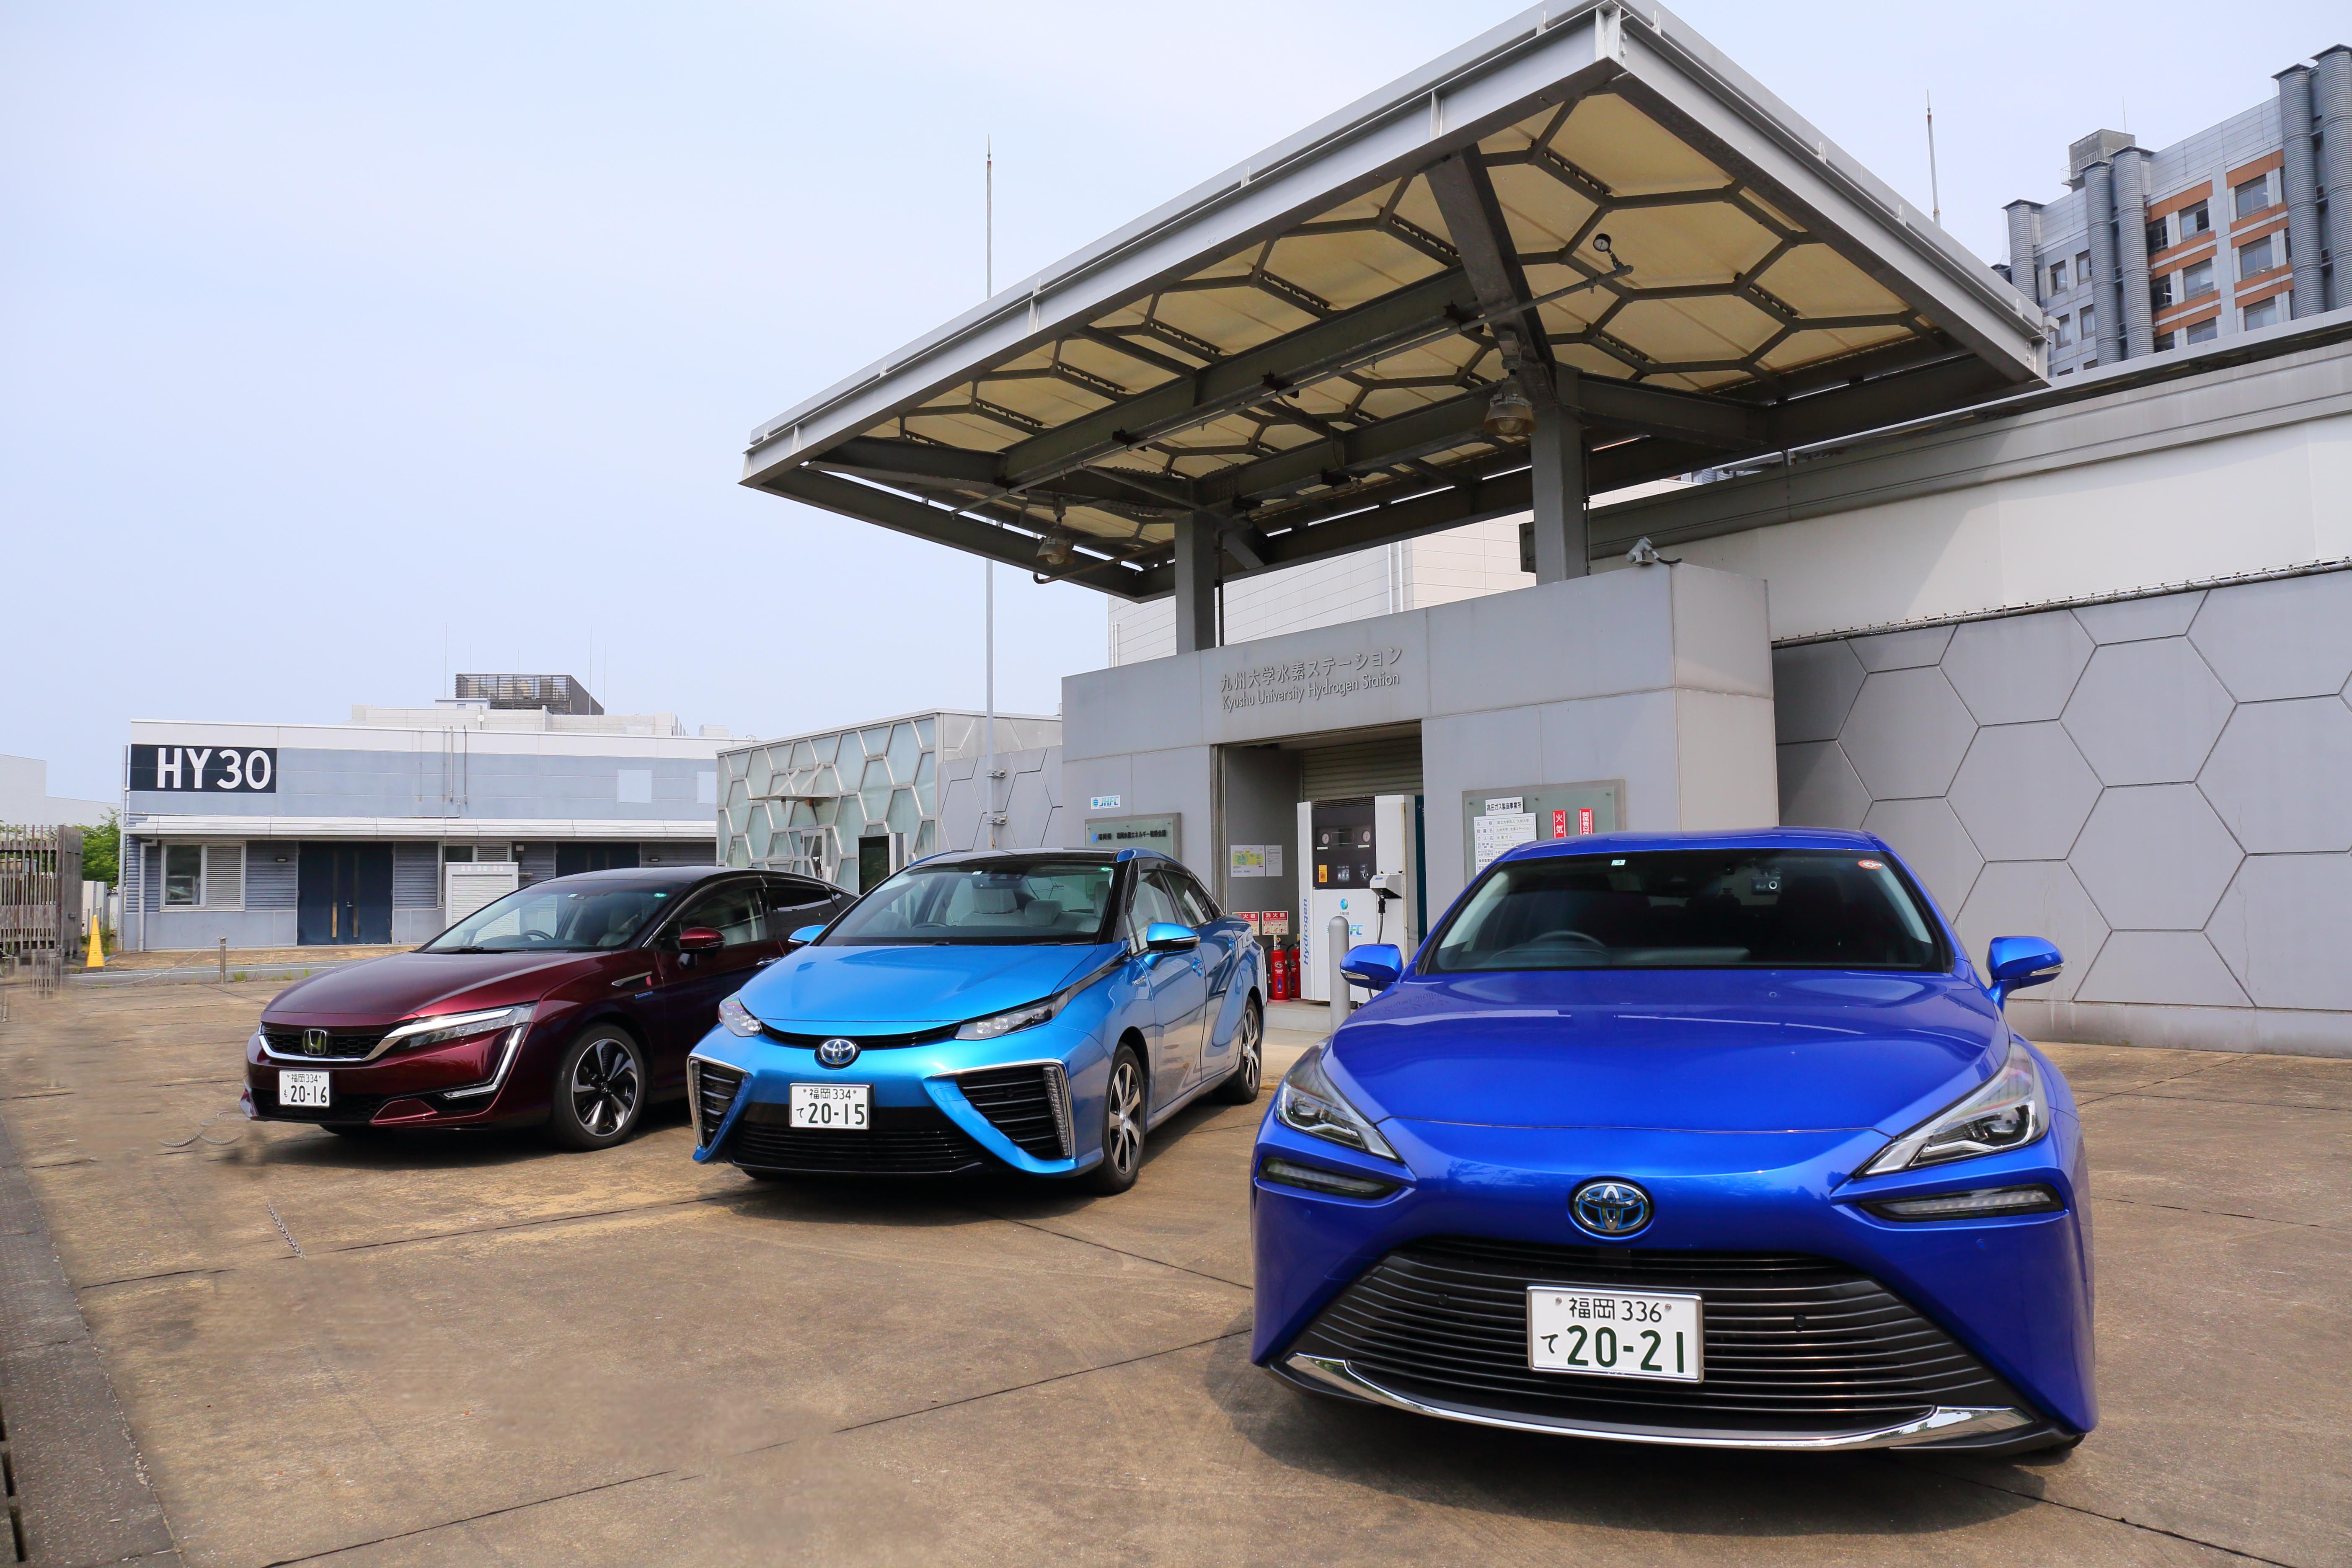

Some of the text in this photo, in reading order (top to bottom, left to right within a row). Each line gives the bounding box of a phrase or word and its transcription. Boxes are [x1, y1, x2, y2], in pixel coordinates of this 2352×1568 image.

[1220, 647, 1402, 692] 九州大学水素ステーション
[1222, 672, 1400, 713] Kyushu University Hydrogen Station
[157, 747, 271, 790] HY30
[1099, 796, 1119, 807] JHFC
[1486, 801, 1522, 811] 高圧ガス製造事業所
[1556, 813, 1564, 834] 火気
[291, 1085, 327, 1103] 20-16
[796, 1103, 865, 1125] て 20-15
[1540, 1324, 1685, 1373] て 20-21
